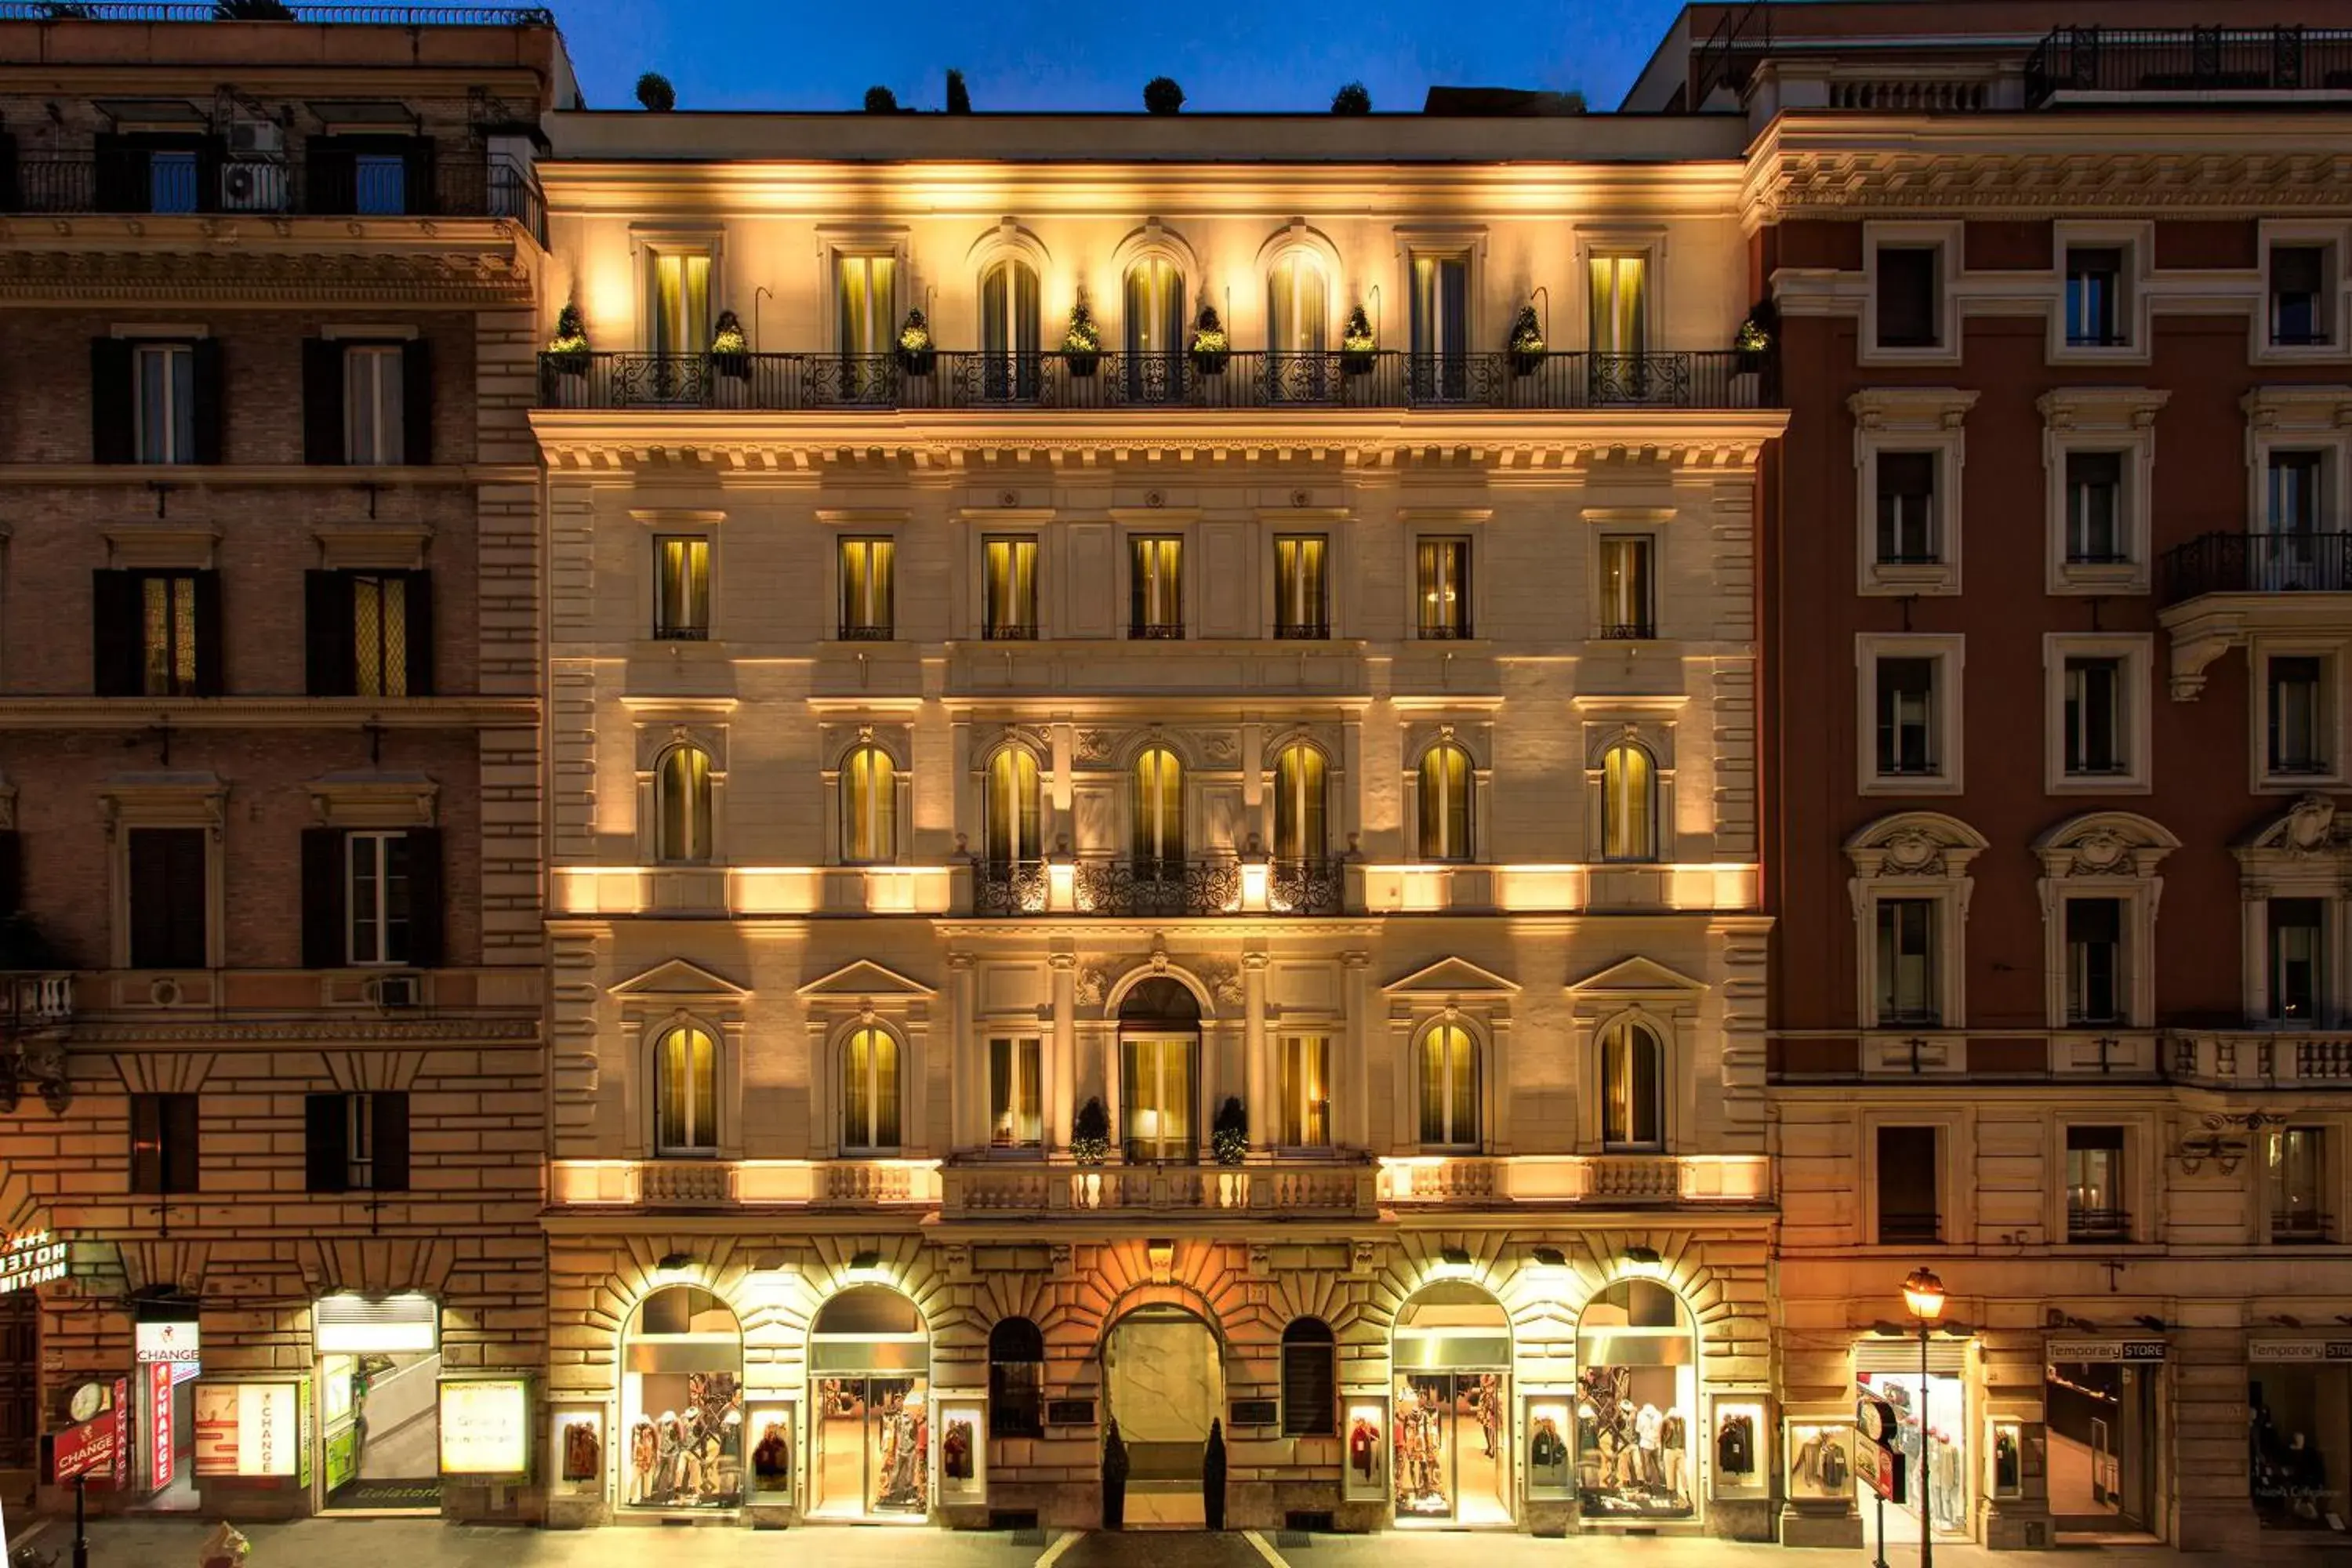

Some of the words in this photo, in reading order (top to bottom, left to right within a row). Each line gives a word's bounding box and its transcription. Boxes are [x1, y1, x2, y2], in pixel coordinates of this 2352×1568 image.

[137, 1349, 200, 1361] CHANGE
[2049, 1345, 2121, 1359] Temporary
[2125, 1345, 2164, 1356] STORE
[158, 1385, 168, 1480] CHANGE
[261, 1406, 272, 1473] CHANGE
[59, 1435, 113, 1468] CHANGE
